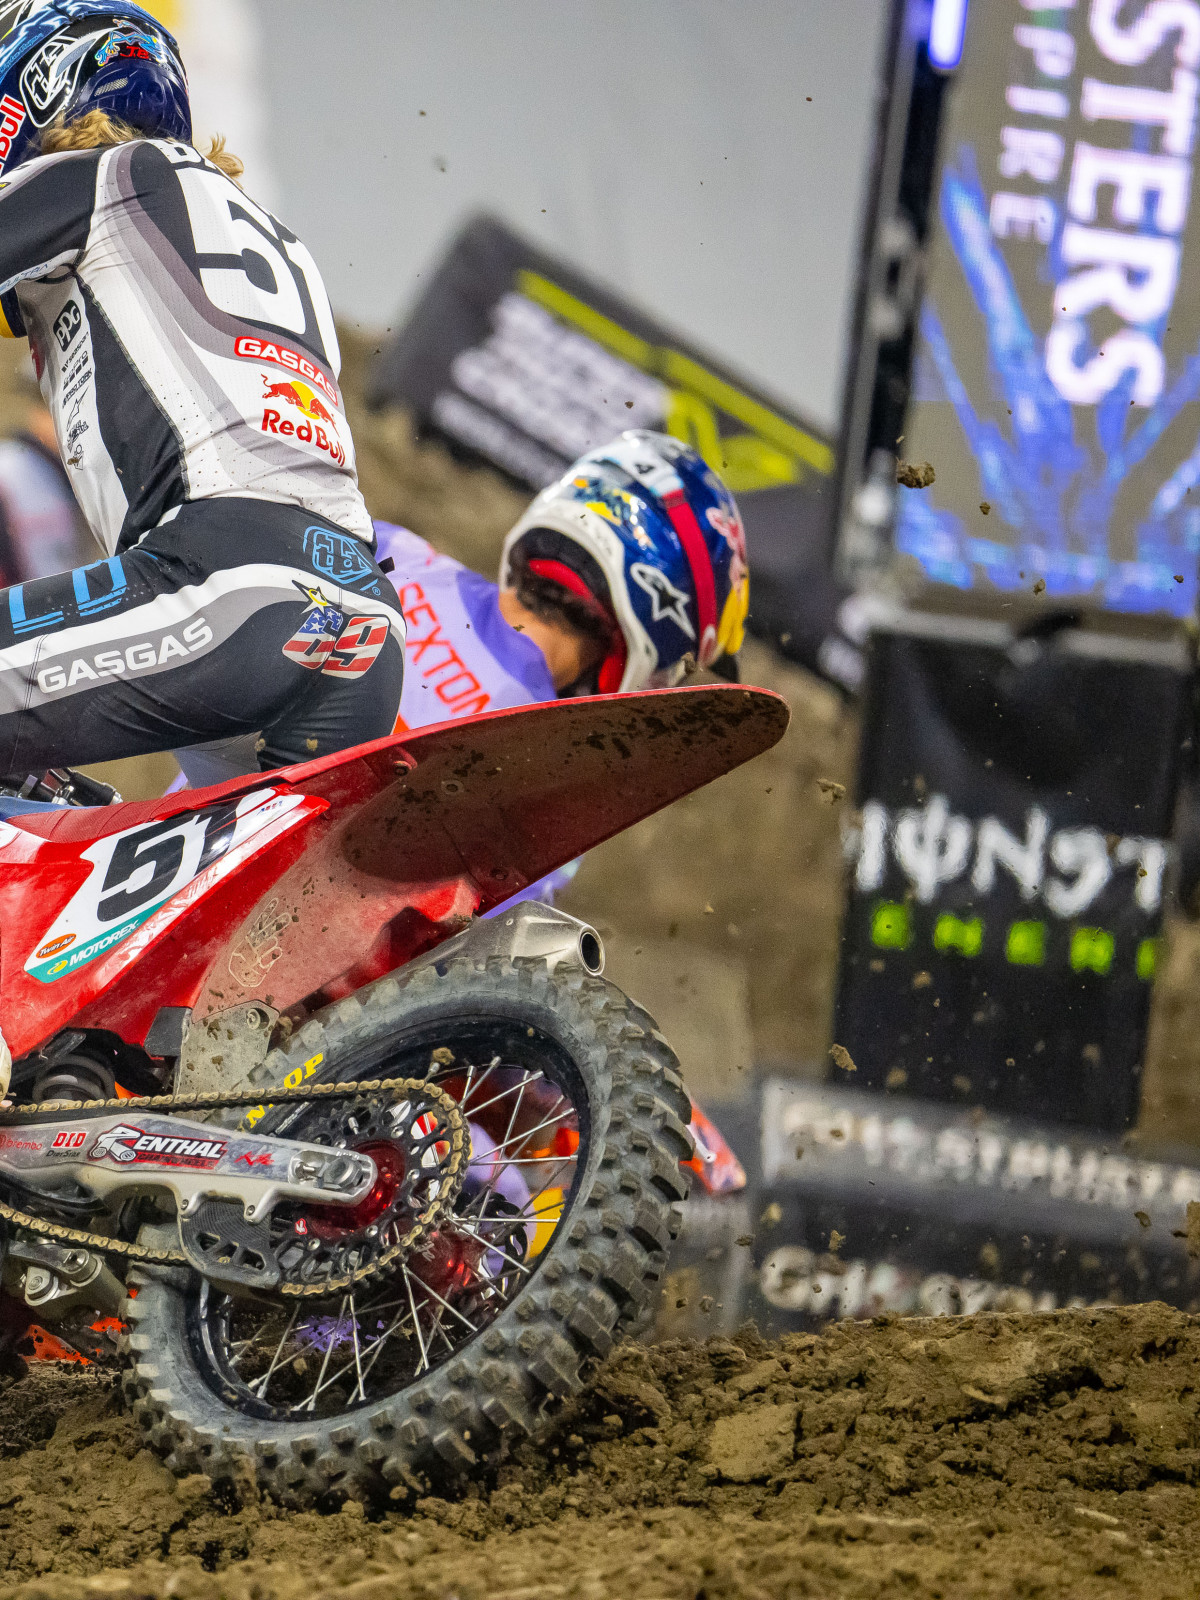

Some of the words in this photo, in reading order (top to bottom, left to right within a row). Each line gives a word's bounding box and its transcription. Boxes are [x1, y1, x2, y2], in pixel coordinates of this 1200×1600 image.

[989, 0, 1076, 245] PIRE
[1046, 0, 1200, 407] STERS
[238, 338, 338, 406] GASGAS
[261, 407, 312, 443] Red
[315, 424, 346, 467] Bull
[37, 617, 214, 694] GASGAS
[68, 919, 140, 967] MOTOREX
[6, 1138, 42, 1151] brembo
[52, 1132, 87, 1148] DID
[97, 1126, 224, 1162] RENTHAL
